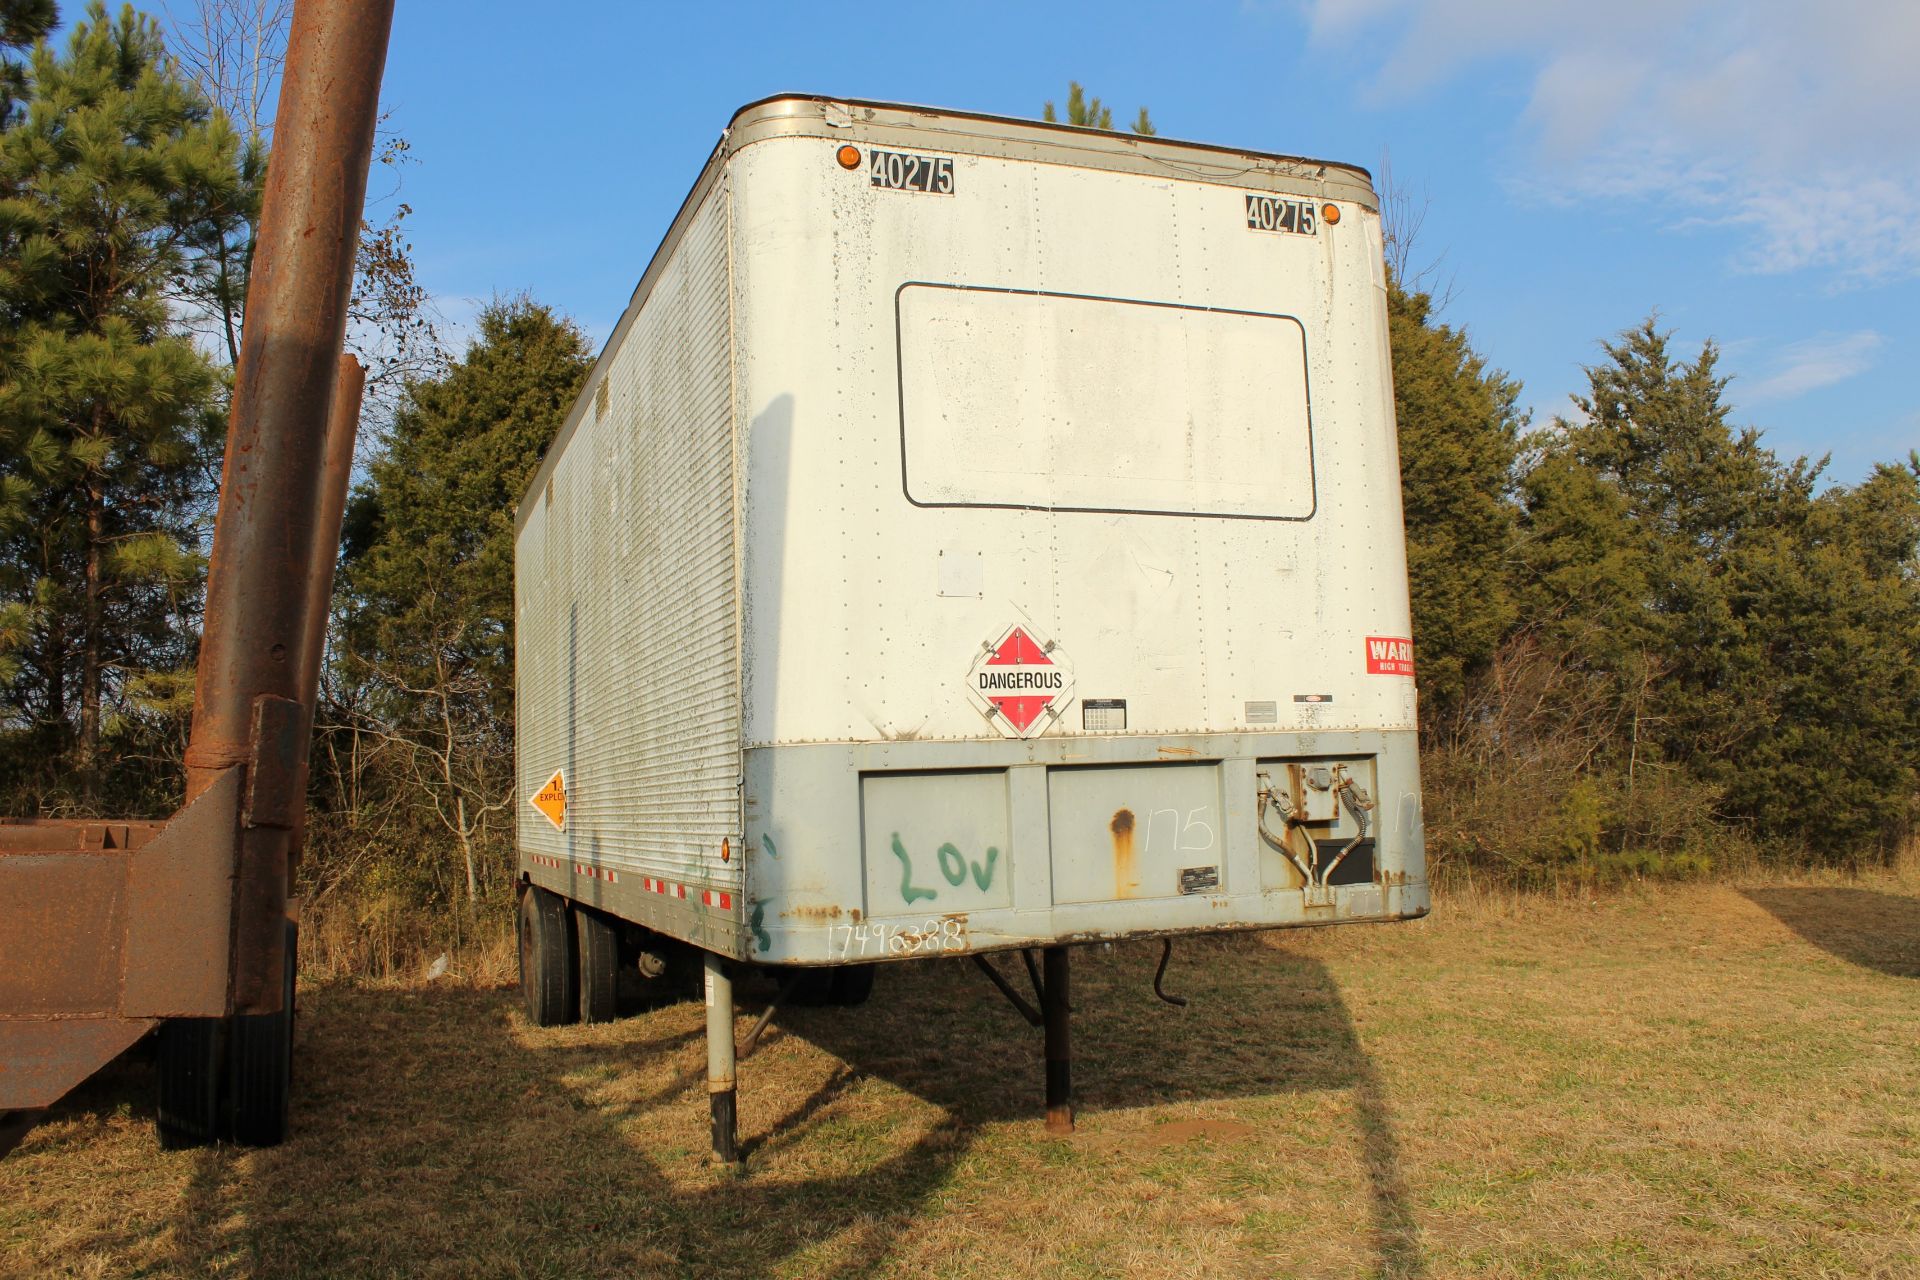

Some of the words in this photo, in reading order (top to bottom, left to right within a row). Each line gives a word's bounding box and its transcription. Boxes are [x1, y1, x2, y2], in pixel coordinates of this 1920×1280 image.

[871, 152, 953, 194] 40275
[1247, 197, 1315, 235] 40275
[979, 672, 1063, 689] DANGEROUS
[1144, 805, 1214, 852] 175
